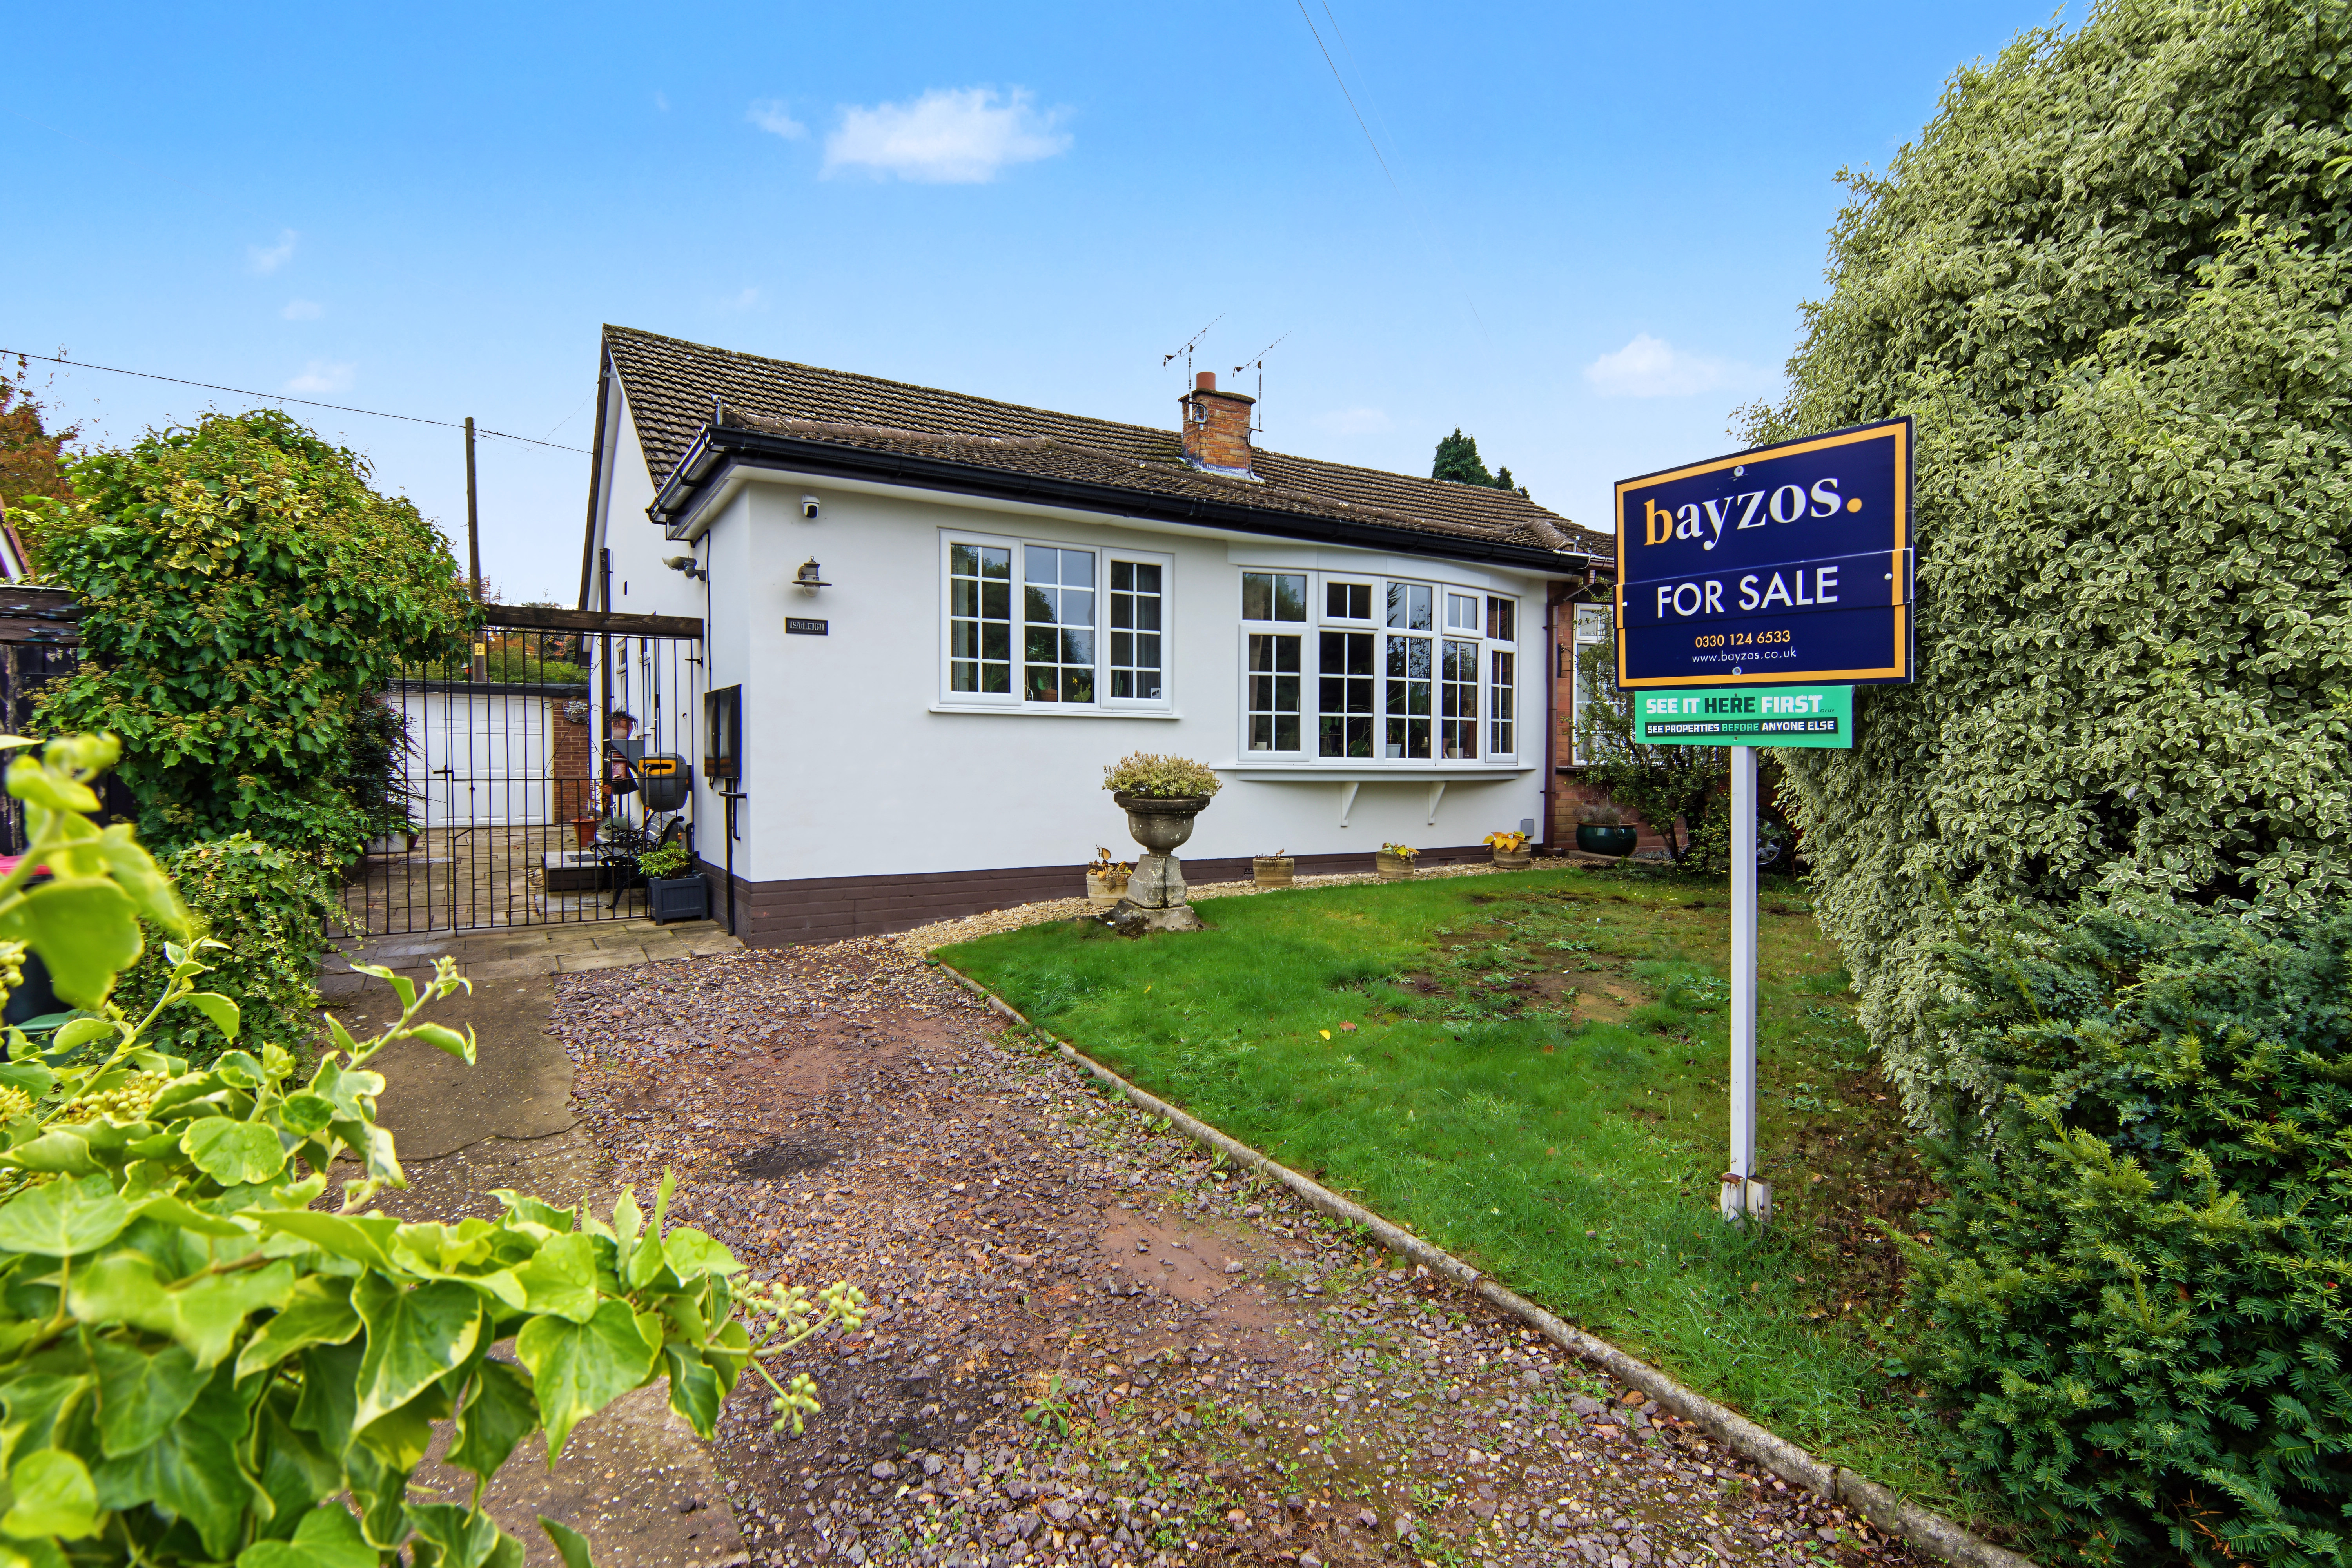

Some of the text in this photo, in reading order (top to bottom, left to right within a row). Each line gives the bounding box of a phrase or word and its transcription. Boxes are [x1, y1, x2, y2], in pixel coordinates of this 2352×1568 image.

[1644, 477, 1863, 551] bayzos.
[1657, 566, 1838, 618] FOR SALE
[1695, 630, 1791, 648] 0330 124 6533
[1691, 646, 1797, 664] www.bayzos.co.uk
[1646, 694, 1823, 714] SEE IT HERE FIRST
[1647, 720, 1834, 733] SEE PROPERTIES BEFORE ANYONE ELSE
